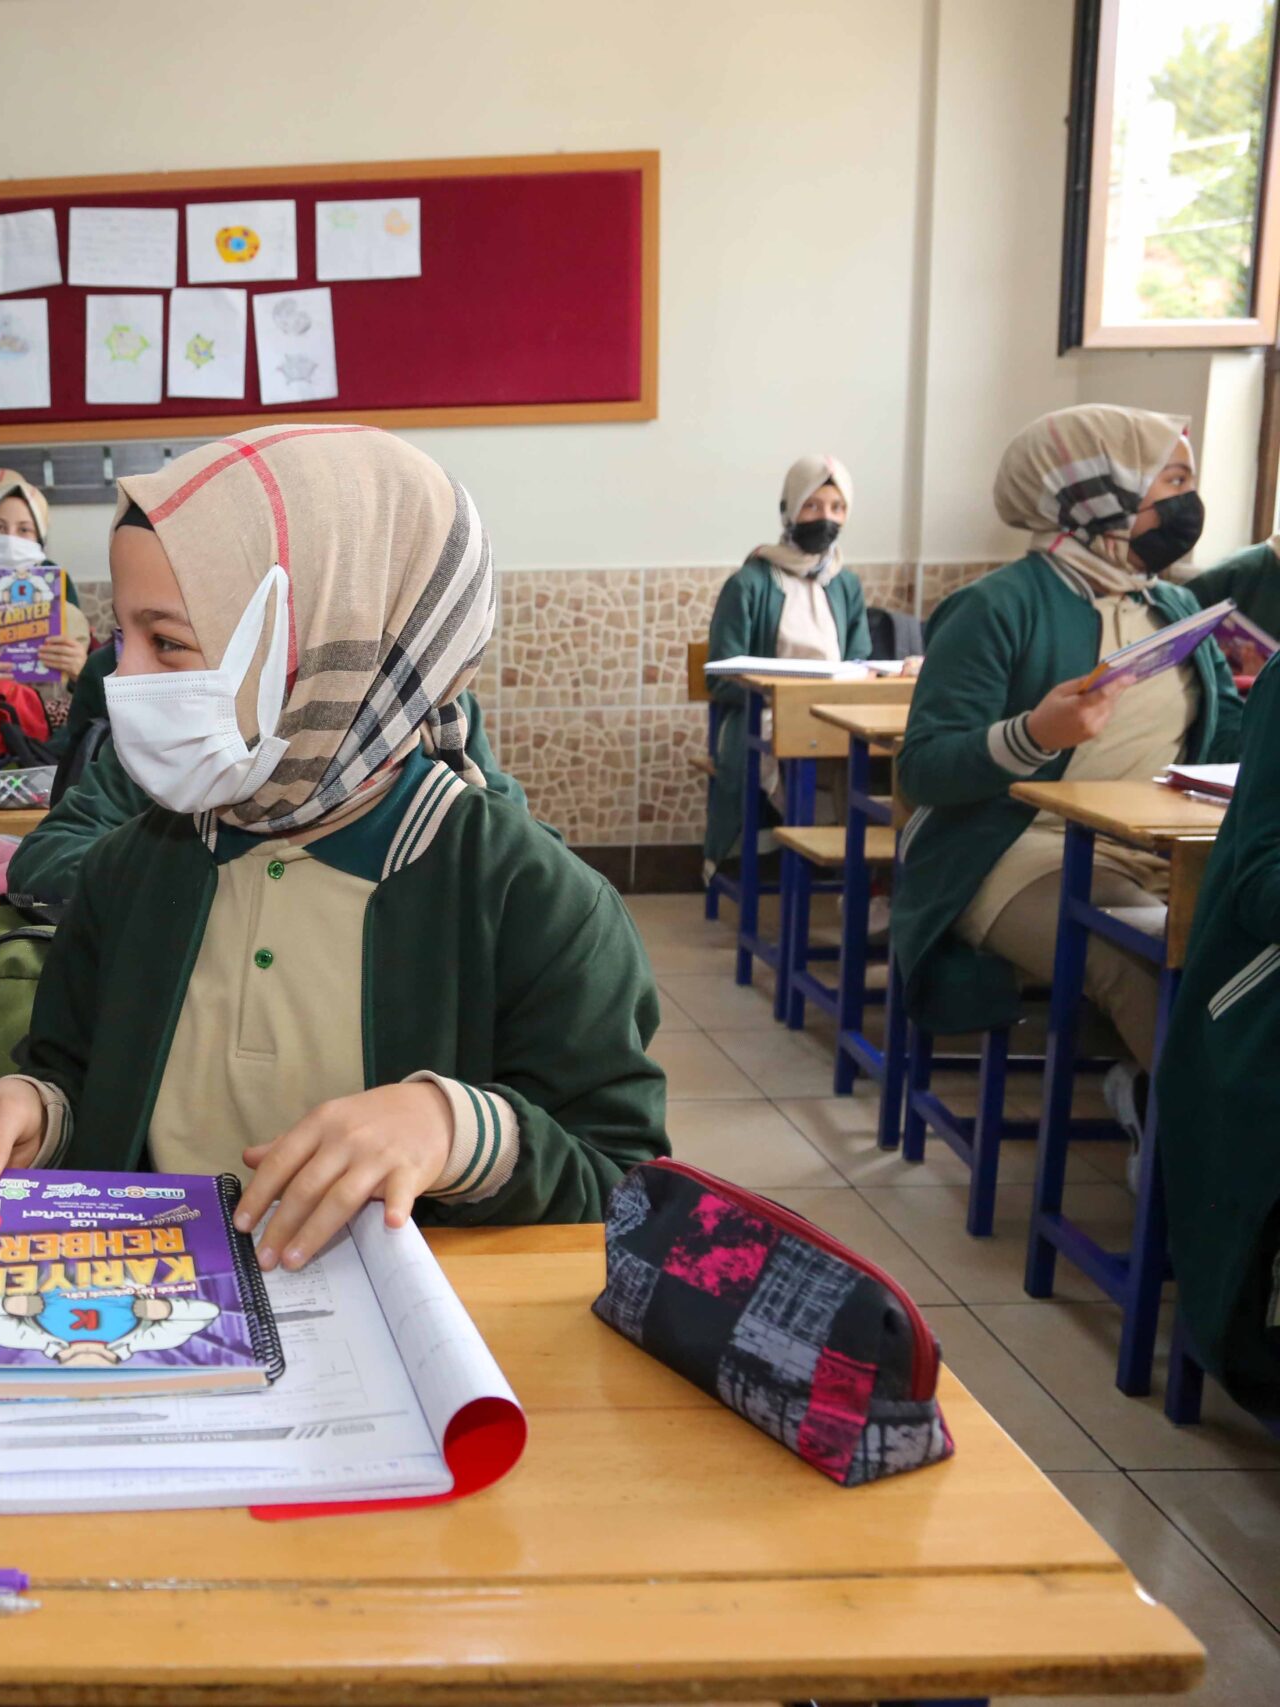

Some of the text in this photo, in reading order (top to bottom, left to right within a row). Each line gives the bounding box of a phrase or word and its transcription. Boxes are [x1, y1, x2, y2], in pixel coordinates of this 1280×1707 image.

[107, 1186, 186, 1199] mega
[22, 1209, 76, 1220] Defteri
[78, 1210, 145, 1221] Planlama
[70, 1219, 98, 1228] LGS
[70, 1309, 99, 1330] K
